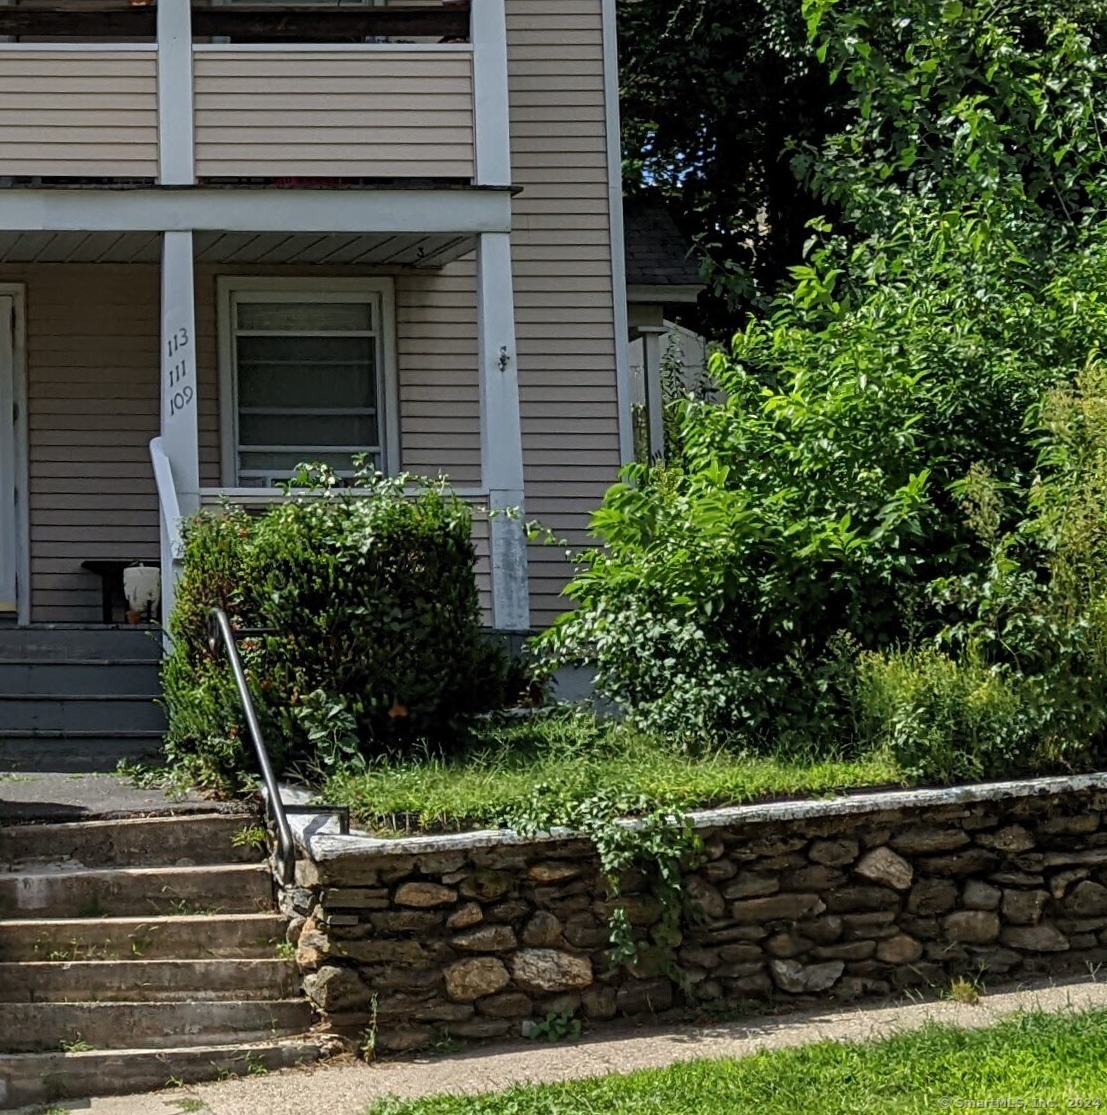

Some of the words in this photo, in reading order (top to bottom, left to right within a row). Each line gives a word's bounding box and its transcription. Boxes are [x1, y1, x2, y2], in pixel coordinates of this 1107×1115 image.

[168, 327, 189, 357] 113
[169, 359, 186, 387] 111
[170, 385, 193, 416] 109
